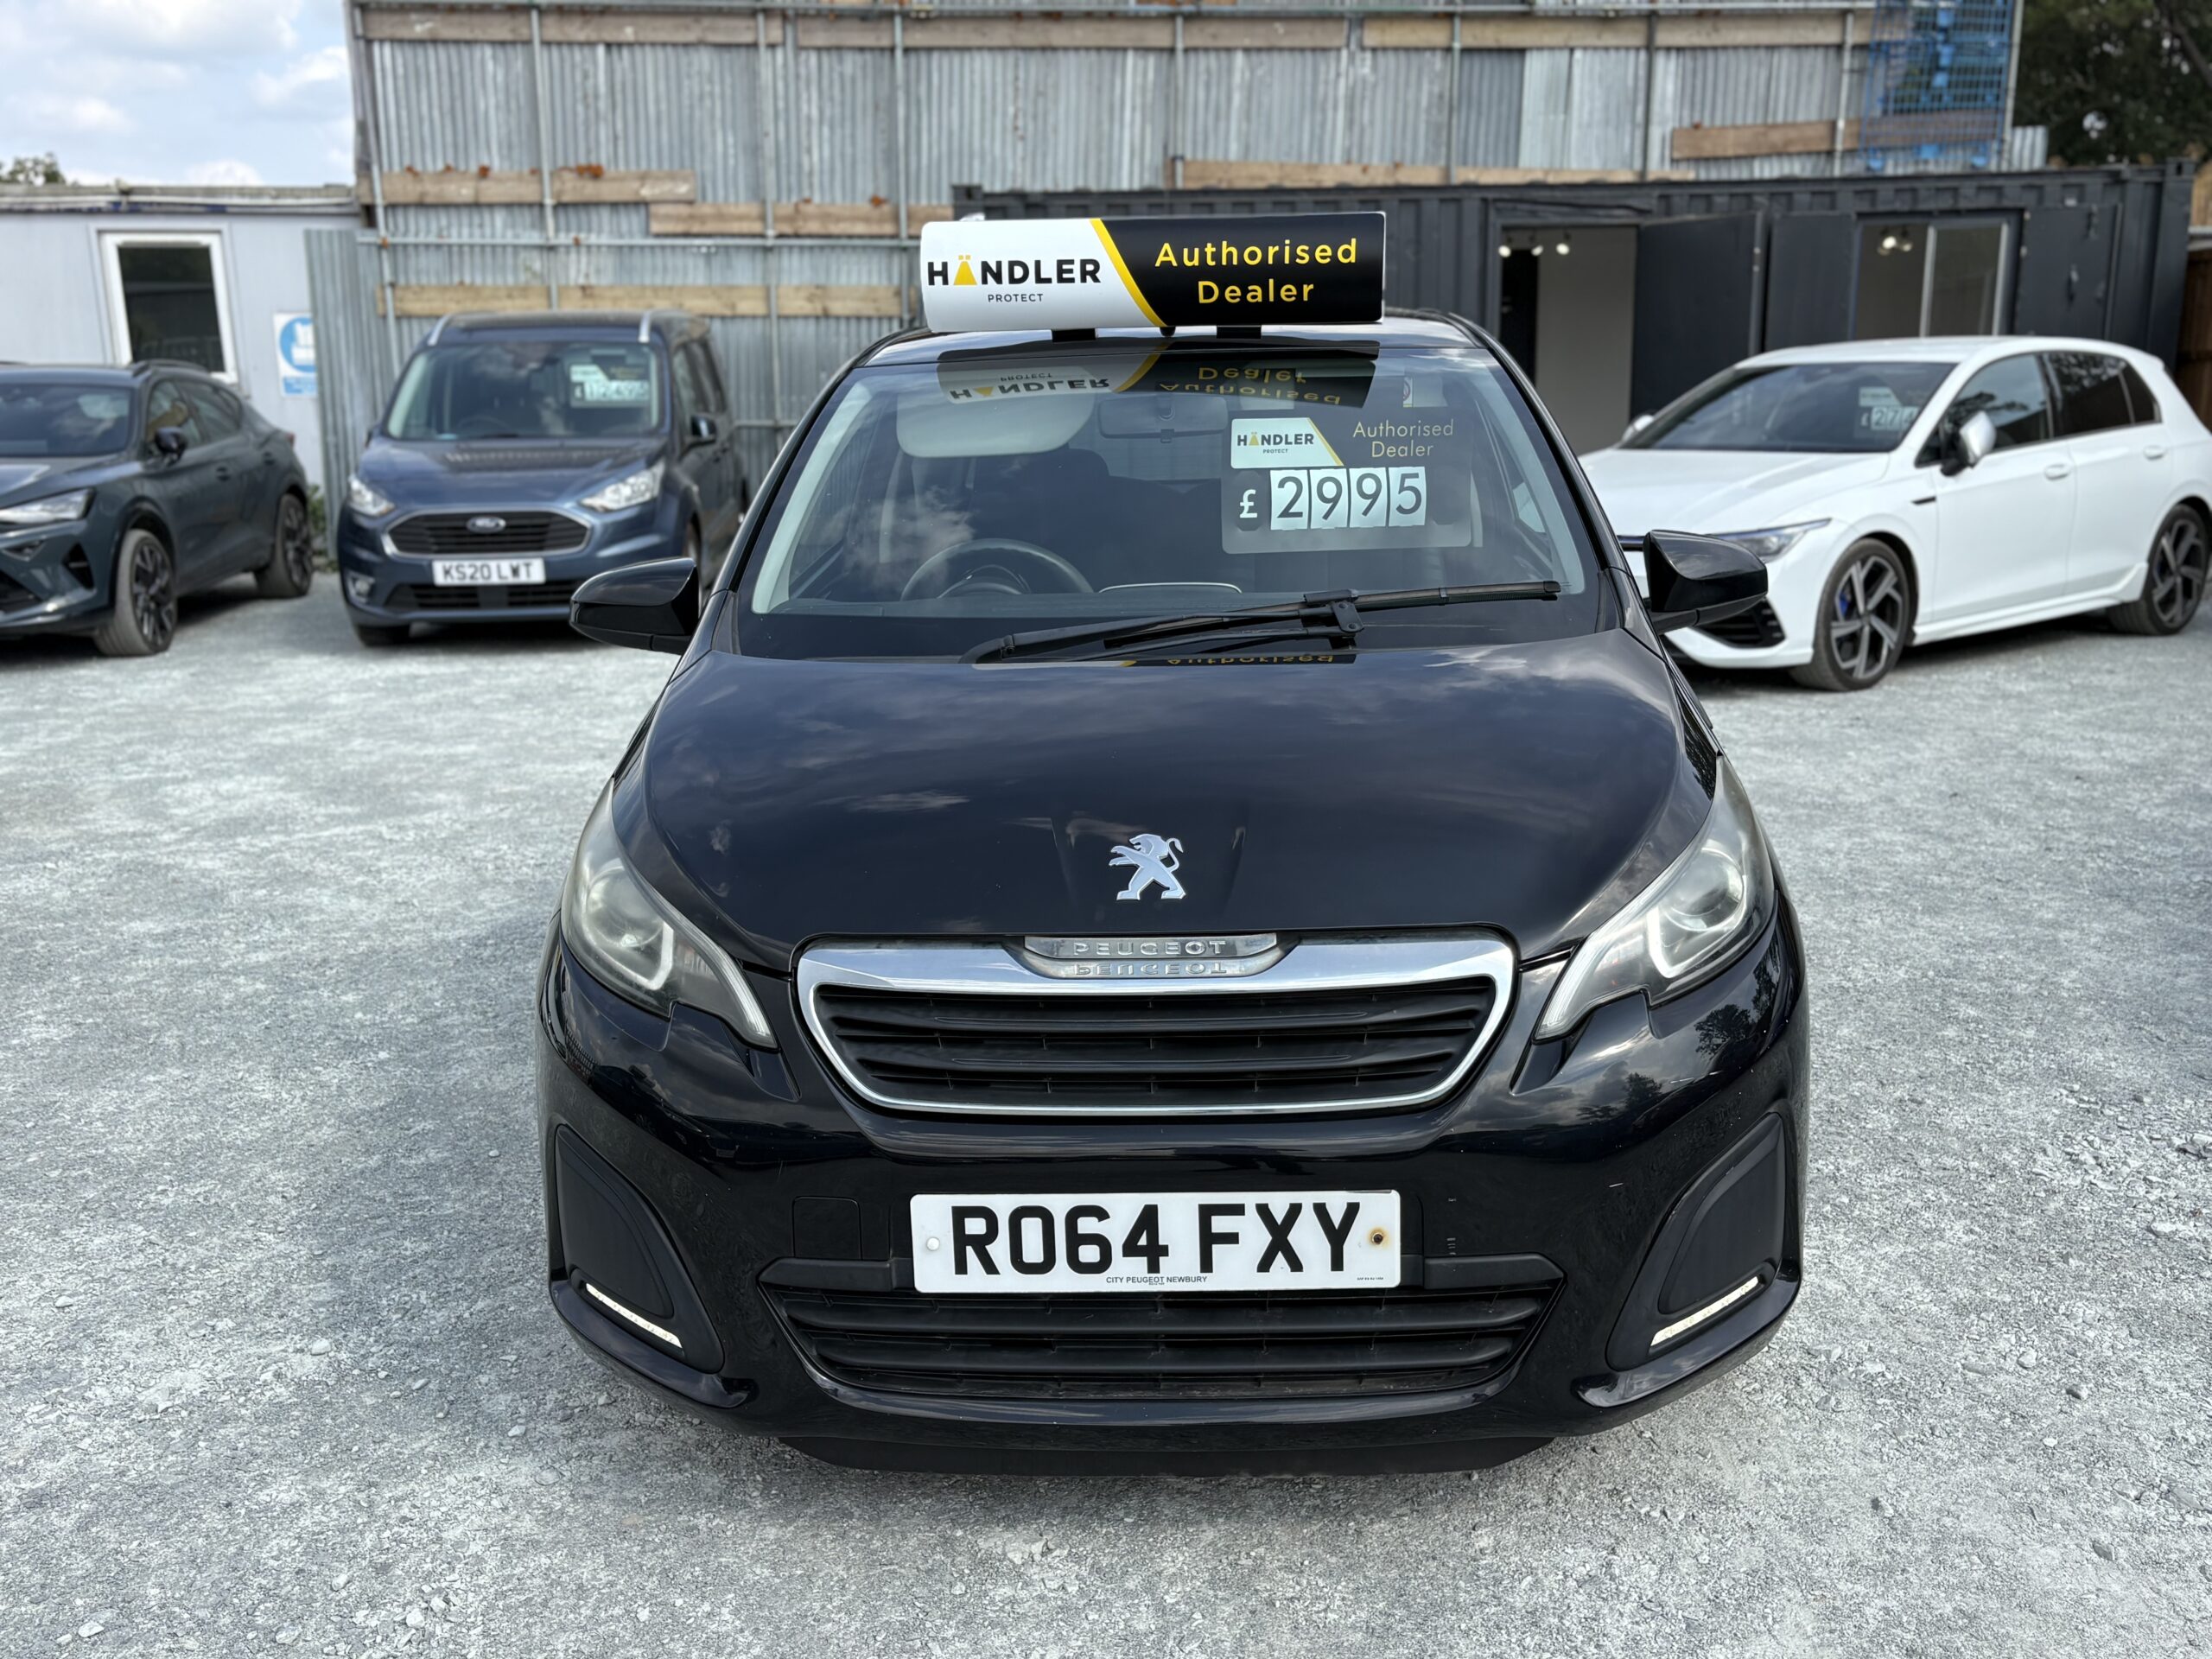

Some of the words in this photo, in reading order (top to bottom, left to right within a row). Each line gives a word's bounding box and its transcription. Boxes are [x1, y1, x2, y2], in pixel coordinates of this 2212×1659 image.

[1154, 238, 1358, 268] Authorised
[927, 254, 1102, 287] HÄNDLER
[988, 292, 1044, 303] PROTECT
[1198, 279, 1315, 305] Dealer
[1352, 418, 1454, 438] Authorised
[1236, 431, 1315, 447] HÄNDLER
[1371, 441, 1434, 458] Dealer
[442, 563, 492, 582] KS20
[497, 562, 534, 581] LWT
[1073, 940, 1227, 957] PEUGEOT
[950, 1204, 1169, 1274] RO64
[1198, 1202, 1361, 1274] FXY
